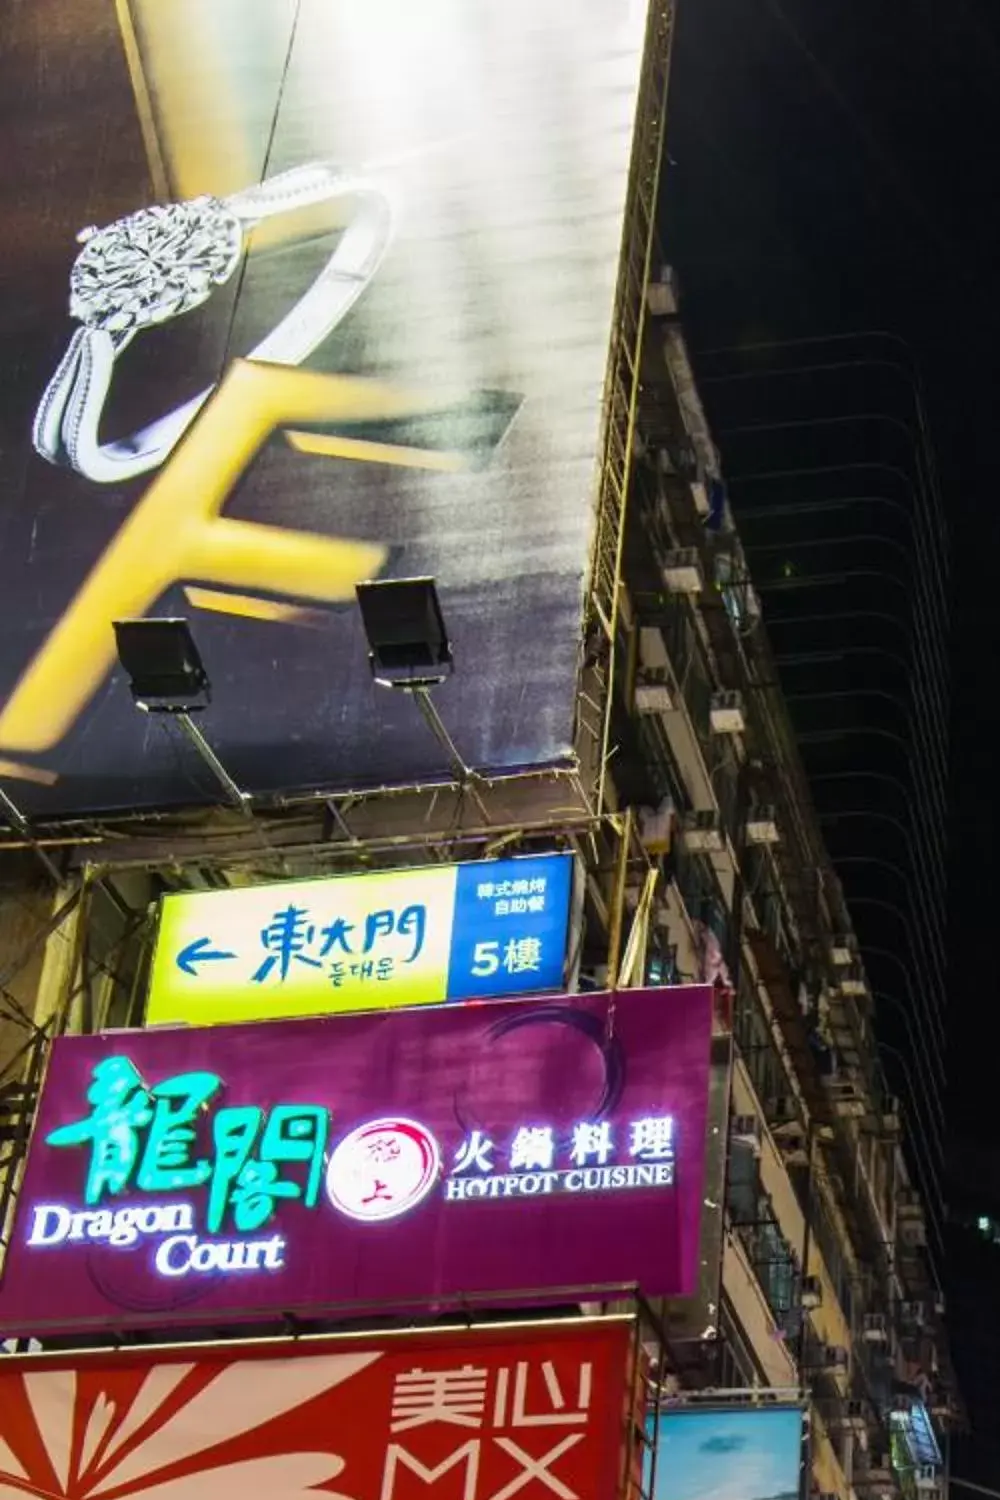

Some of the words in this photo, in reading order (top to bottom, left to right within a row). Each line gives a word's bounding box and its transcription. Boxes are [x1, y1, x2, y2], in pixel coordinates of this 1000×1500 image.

[250, 903, 427, 983] 東大門
[470, 936, 543, 977] 5樓
[451, 1116, 675, 1173] 火鍋料理
[446, 1170, 557, 1201] HOTPOT
[563, 1164, 674, 1194] CUISINE
[26, 1202, 193, 1248] Dragon
[155, 1231, 286, 1277] Court
[389, 1360, 592, 1433] 美心
